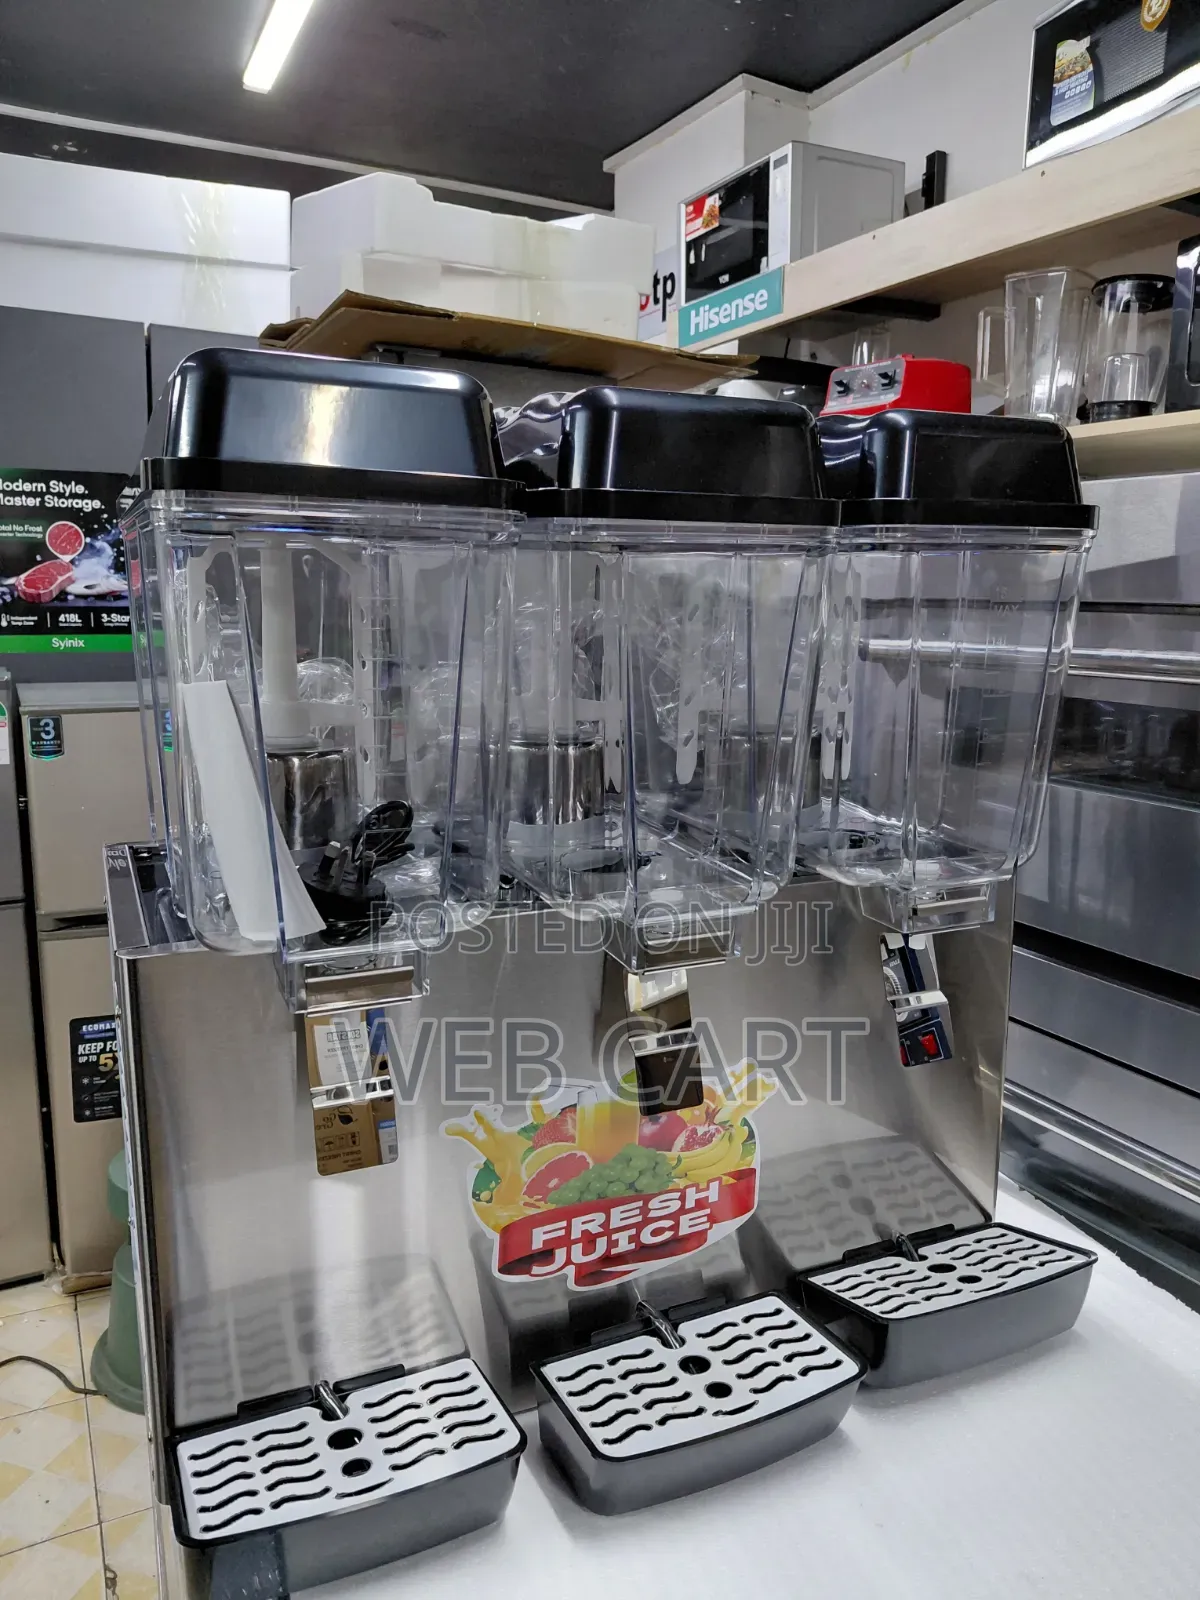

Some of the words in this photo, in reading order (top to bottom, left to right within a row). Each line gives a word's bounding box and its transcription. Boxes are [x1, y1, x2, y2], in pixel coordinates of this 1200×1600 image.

[689, 288, 769, 336] Hisense
[49, 479, 89, 497] Style.
[44, 494, 106, 512] Storage.
[13, 524, 24, 532] No
[24, 524, 43, 532] Frost
[58, 613, 82, 623] 418L
[101, 613, 130, 623] 3-Star
[51, 637, 85, 650] Syinix
[39, 718, 55, 740] 3
[77, 1041, 104, 1055] KEEP
[78, 1056, 88, 1064] UP
[88, 1055, 98, 1063] TO
[530, 1179, 720, 1251] FRESH
[530, 1207, 712, 1275] JUICE
